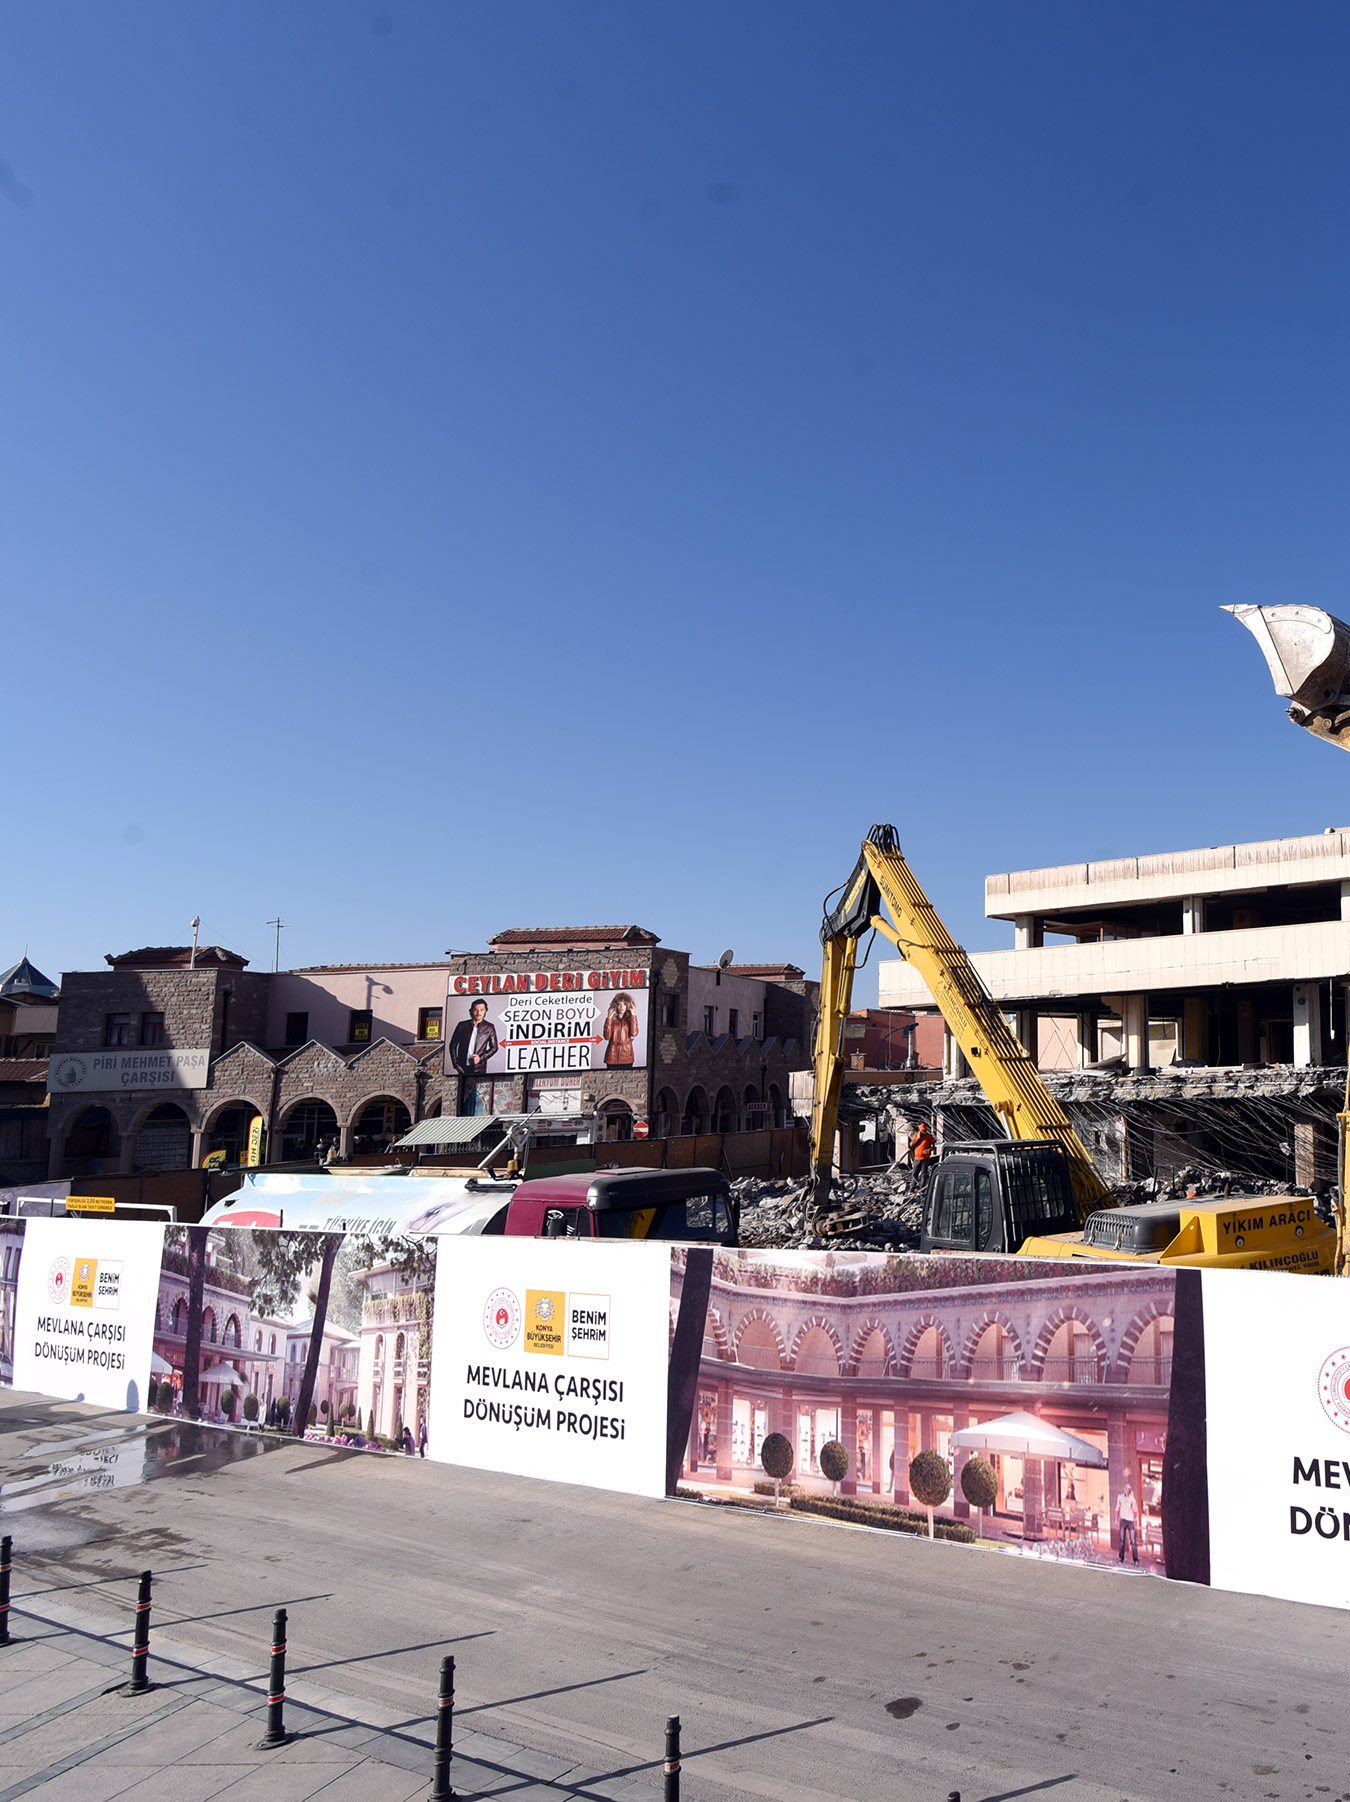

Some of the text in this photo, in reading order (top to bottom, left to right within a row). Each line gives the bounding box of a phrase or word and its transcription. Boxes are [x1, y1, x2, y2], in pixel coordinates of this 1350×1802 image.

[879, 875, 902, 918] SUMITOMO
[454, 974, 528, 993] CEYLAN
[509, 995, 593, 1007] Deri Ceketlerde
[504, 1007, 596, 1023] SEZON BOYU
[93, 1055, 205, 1070] PİRİ MEHMET PAŞA
[506, 1045, 590, 1070] LEATHER
[121, 1070, 175, 1087] ÇARŞISI
[1223, 1209, 1311, 1235] YIKIM ARACI
[1249, 1250, 1319, 1270] KILINÇOĞLU
[37, 1316, 126, 1344] MEVLANA ÇARŞISI
[35, 1342, 125, 1371] DÖNÜŞÜM PROJESİ
[466, 1364, 624, 1405] MEVLANA ÇARŞISI
[463, 1399, 625, 1441] DÖNÜŞÜM PROJESİ
